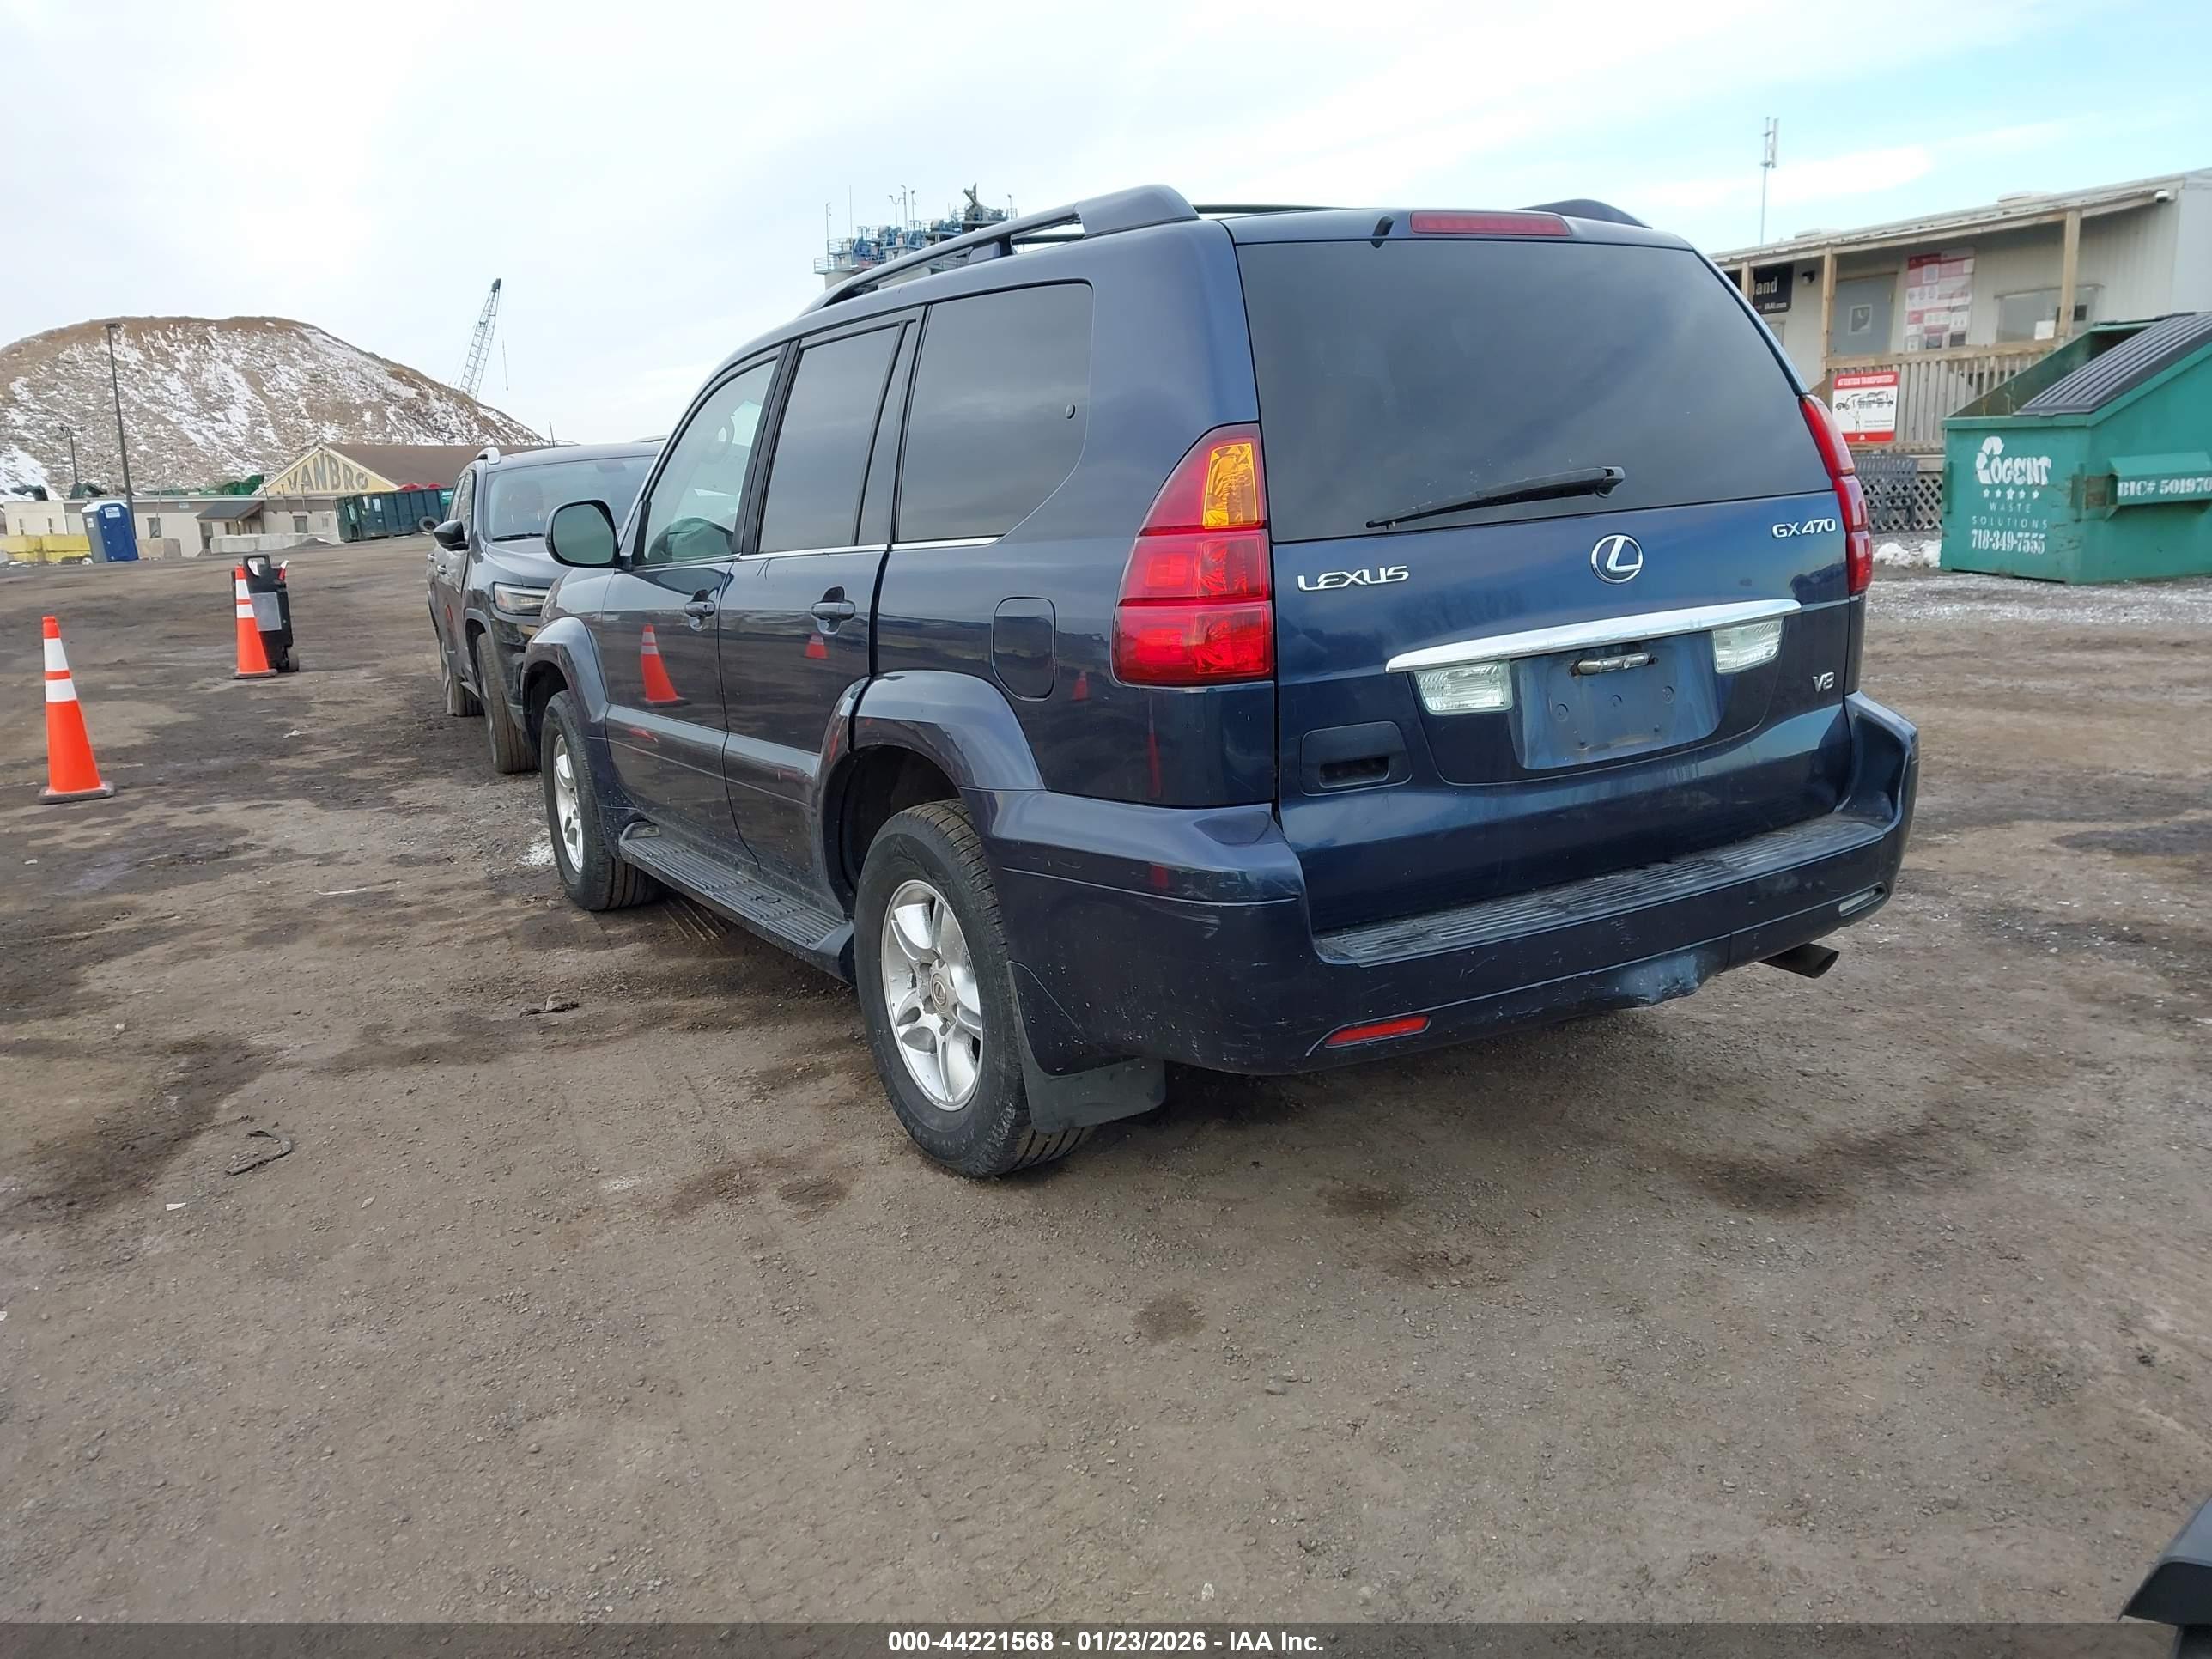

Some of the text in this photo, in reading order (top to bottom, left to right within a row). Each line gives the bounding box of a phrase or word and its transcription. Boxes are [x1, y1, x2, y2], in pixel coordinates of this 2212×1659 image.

[287, 453, 368, 491] VANBRO
[2118, 477, 2212, 496] BIC# 501970
[1990, 502, 2032, 514] WASTE
[1972, 515, 2048, 529] SOLUTIONS
[1972, 529, 2045, 555] 718-349-7555
[1297, 564, 1410, 592] LEXUS
[1812, 671, 1835, 693] V8
